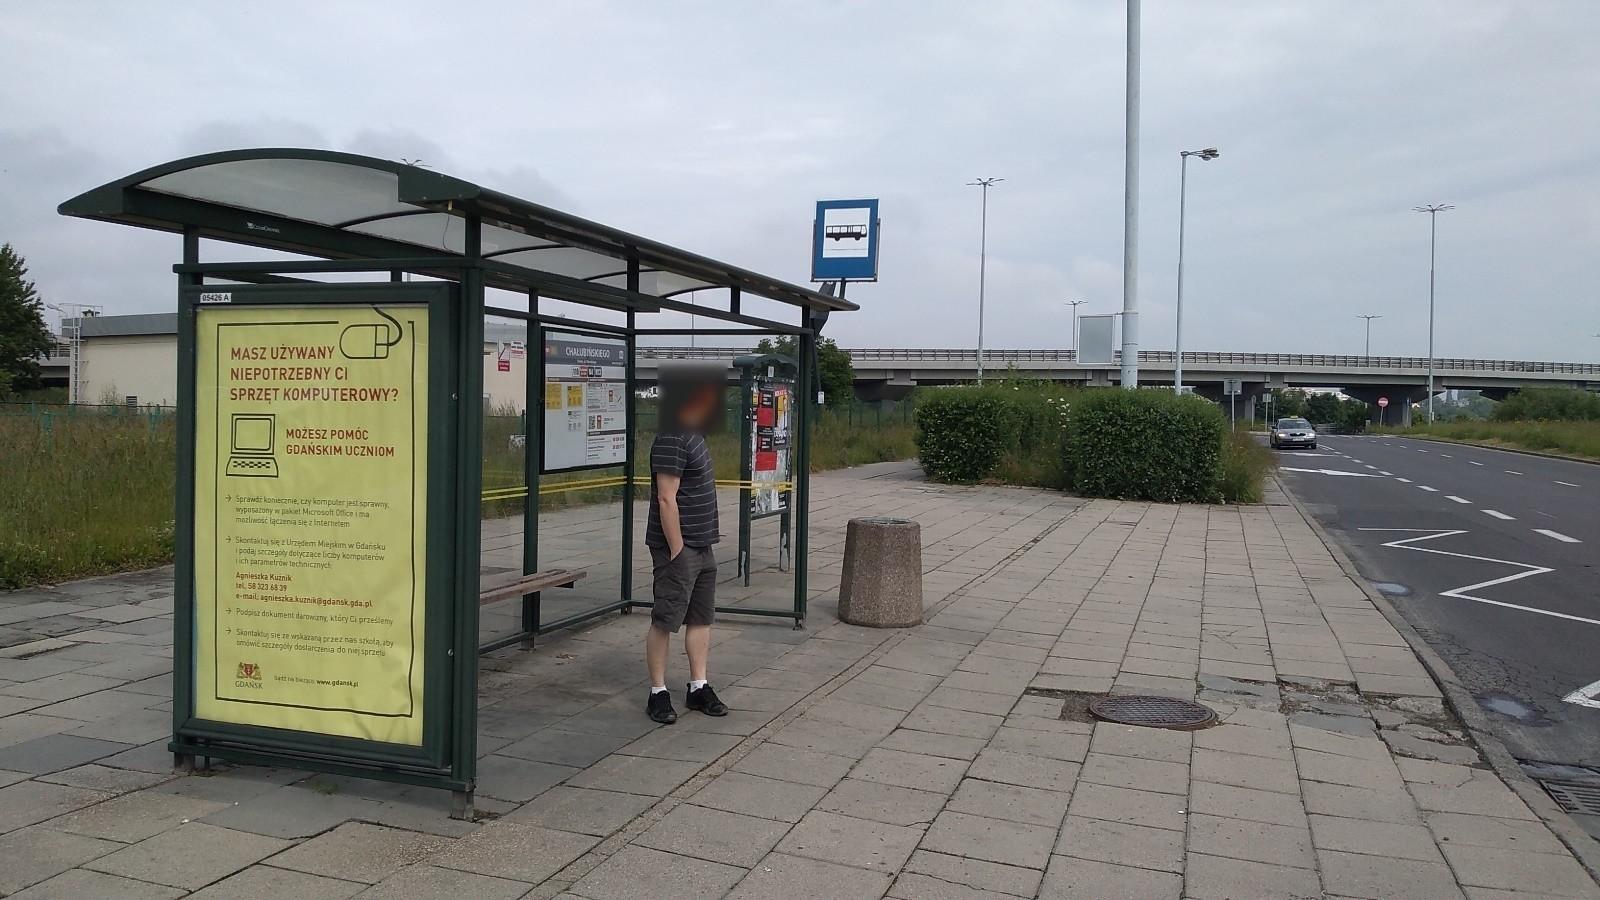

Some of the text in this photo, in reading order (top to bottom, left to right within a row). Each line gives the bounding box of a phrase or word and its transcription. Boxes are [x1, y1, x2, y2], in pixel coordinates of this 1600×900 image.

[223, 293, 230, 301] A
[231, 344, 335, 361] MASZ UŻYWANY
[230, 367, 348, 381] NIEPOTRZEBNY CI
[230, 387, 398, 405] SPRZĘT KOMPUTEROWY?
[286, 427, 369, 441] MOŻESZ POMÓC
[286, 442, 394, 457] GDAŃSKIM UCZNIOM
[313, 498, 346, 508] komputer
[281, 508, 301, 516] pakiet
[302, 508, 334, 517] Microsoft
[335, 509, 354, 518] Office
[235, 572, 269, 581] Agnieszka
[247, 582, 257, 590] 58
[261, 610, 295, 619] dokument
[330, 614, 349, 624] który
[344, 636, 358, 644] nas
[336, 645, 346, 654] do
[234, 680, 264, 690] GDAŃSK
